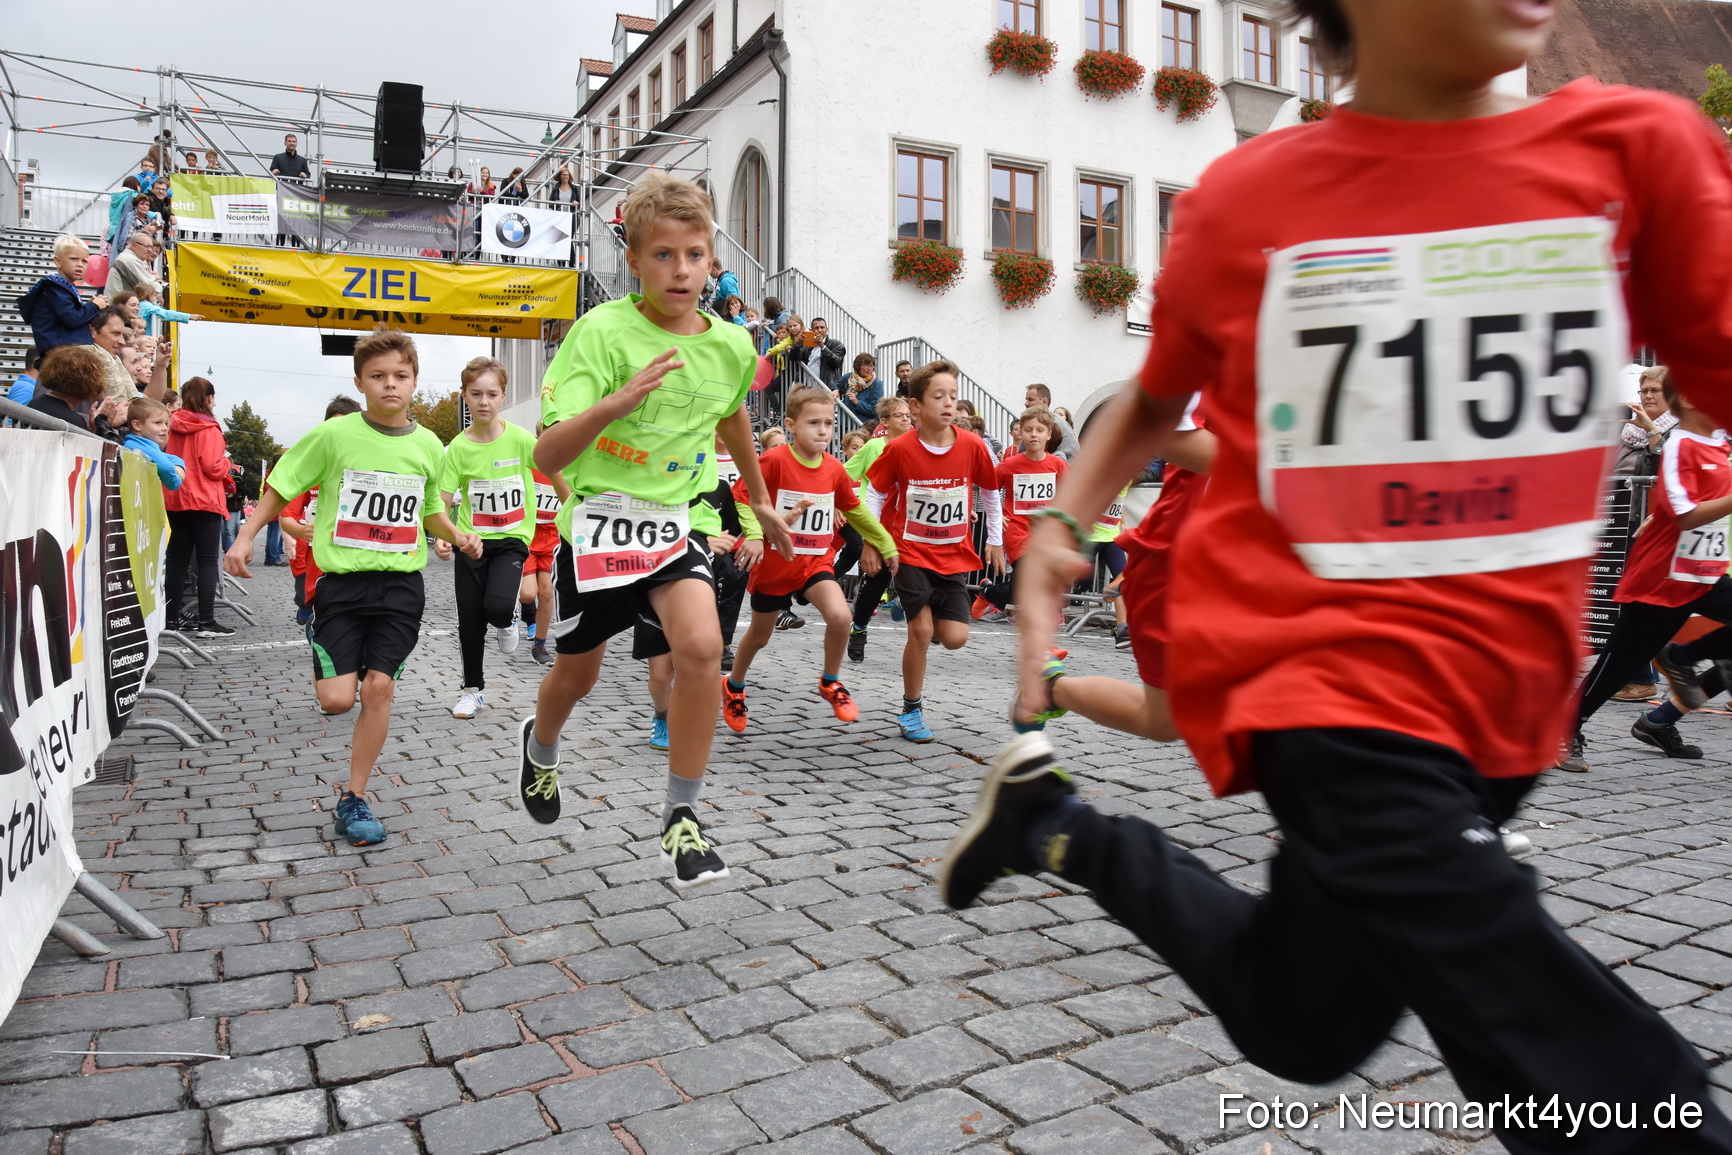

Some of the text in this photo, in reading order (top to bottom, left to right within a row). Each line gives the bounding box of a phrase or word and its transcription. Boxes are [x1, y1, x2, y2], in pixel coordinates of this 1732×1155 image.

[172, 201, 195, 212] eht!
[283, 198, 348, 217] BOCK
[226, 214, 270, 222] NeuerMarkt
[357, 207, 387, 217] OFFICE
[389, 210, 433, 222] INDUSTRY
[499, 213, 529, 227] BMW
[373, 221, 453, 235] www.bockonline.de
[1425, 233, 1608, 283] BOCK
[200, 270, 292, 287] Neumarkter Stadtlauf
[342, 266, 431, 302] ZIEL
[200, 298, 283, 310] Neumarkter Stadtlauf
[478, 293, 558, 302] Neumarkter Stadtlauf
[450, 314, 523, 324] Neumarkter Stadtlauf
[1295, 310, 1602, 446] 7155
[383, 476, 420, 489] BOCK
[1018, 483, 1053, 498] 7128
[350, 488, 417, 523] 7009
[474, 488, 521, 512] 7110
[914, 499, 963, 524] 7204
[492, 517, 508, 525] Max
[368, 527, 393, 541] Max
[586, 513, 680, 549] 7069
[924, 528, 949, 537] Jakob
[795, 536, 817, 546] Marc
[1584, 588, 1608, 596] Freizeit
[110, 615, 131, 630] Freizeit
[112, 651, 145, 669] Stadtbusse
